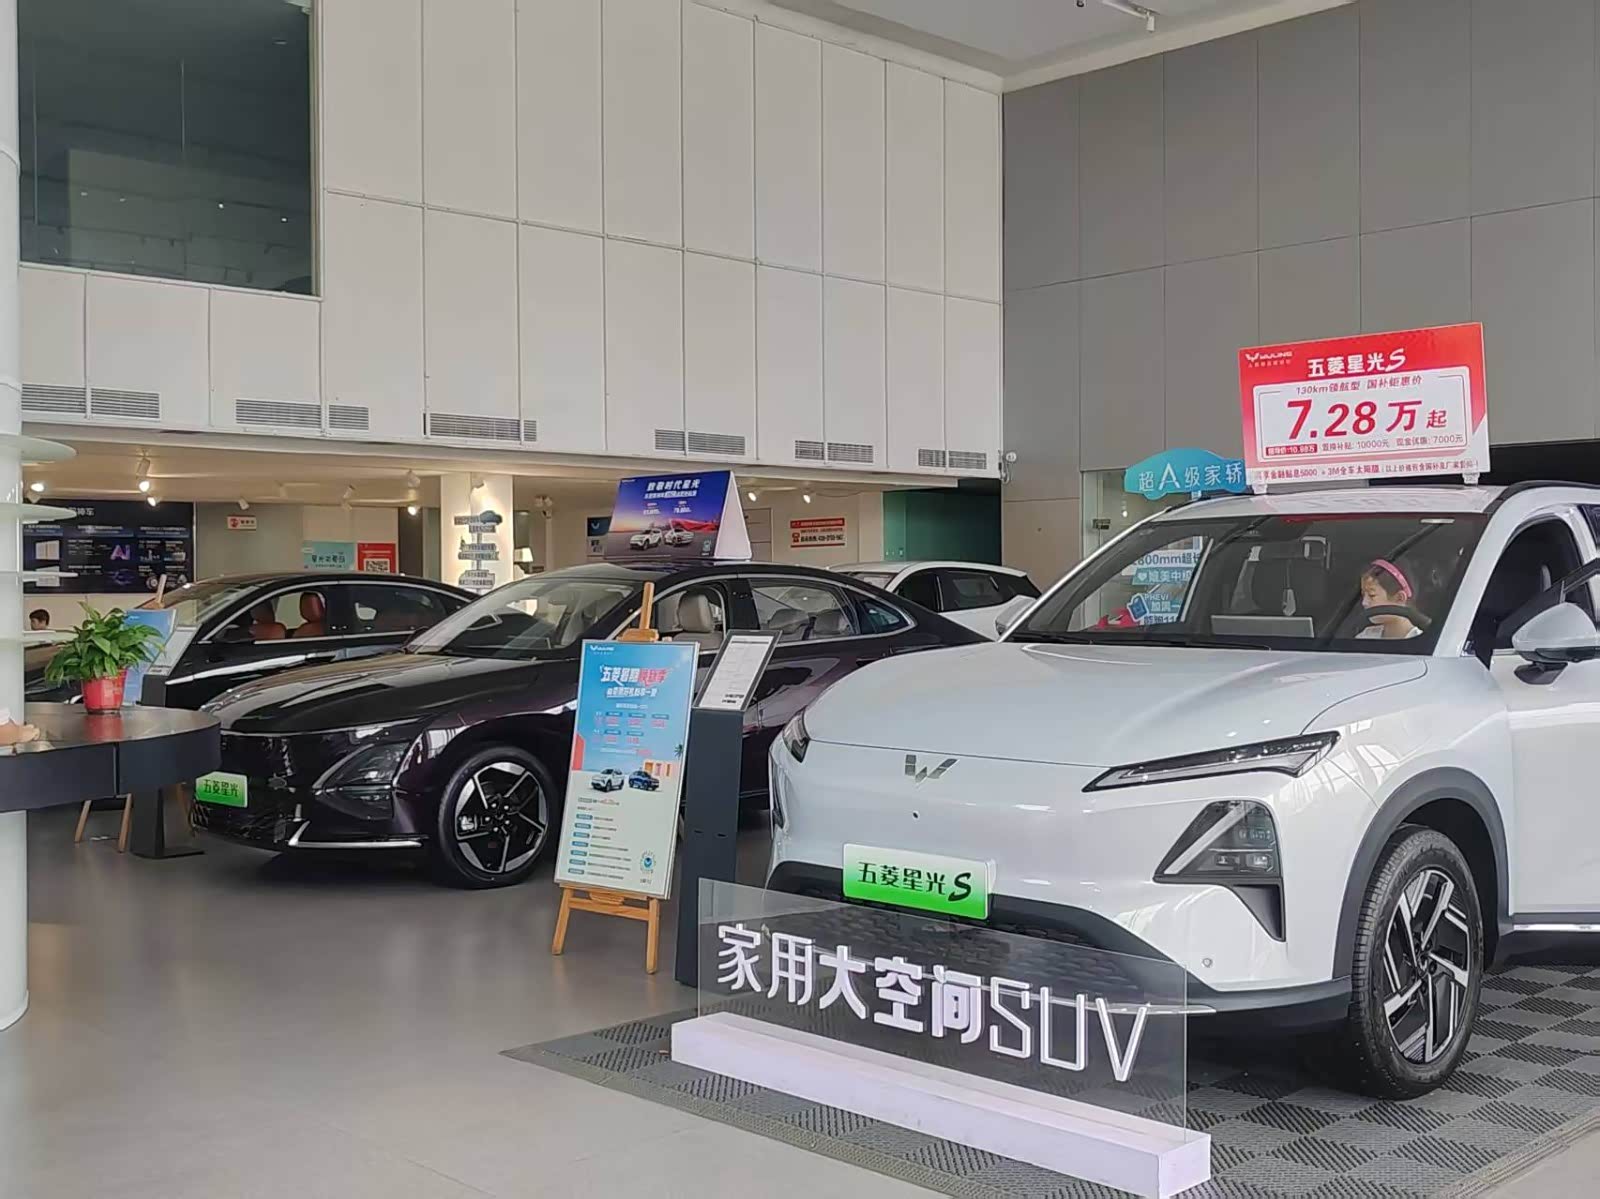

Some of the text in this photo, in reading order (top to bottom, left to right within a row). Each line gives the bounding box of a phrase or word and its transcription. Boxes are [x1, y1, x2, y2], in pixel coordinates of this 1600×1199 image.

[1307, 348, 1406, 378] 五菱星光S
[1138, 462, 1243, 493] 超A级家轿
[203, 779, 239, 797] 五菱星光
[857, 861, 972, 902] 五菱星光S
[716, 922, 1152, 1083] 家用大空间SUV
